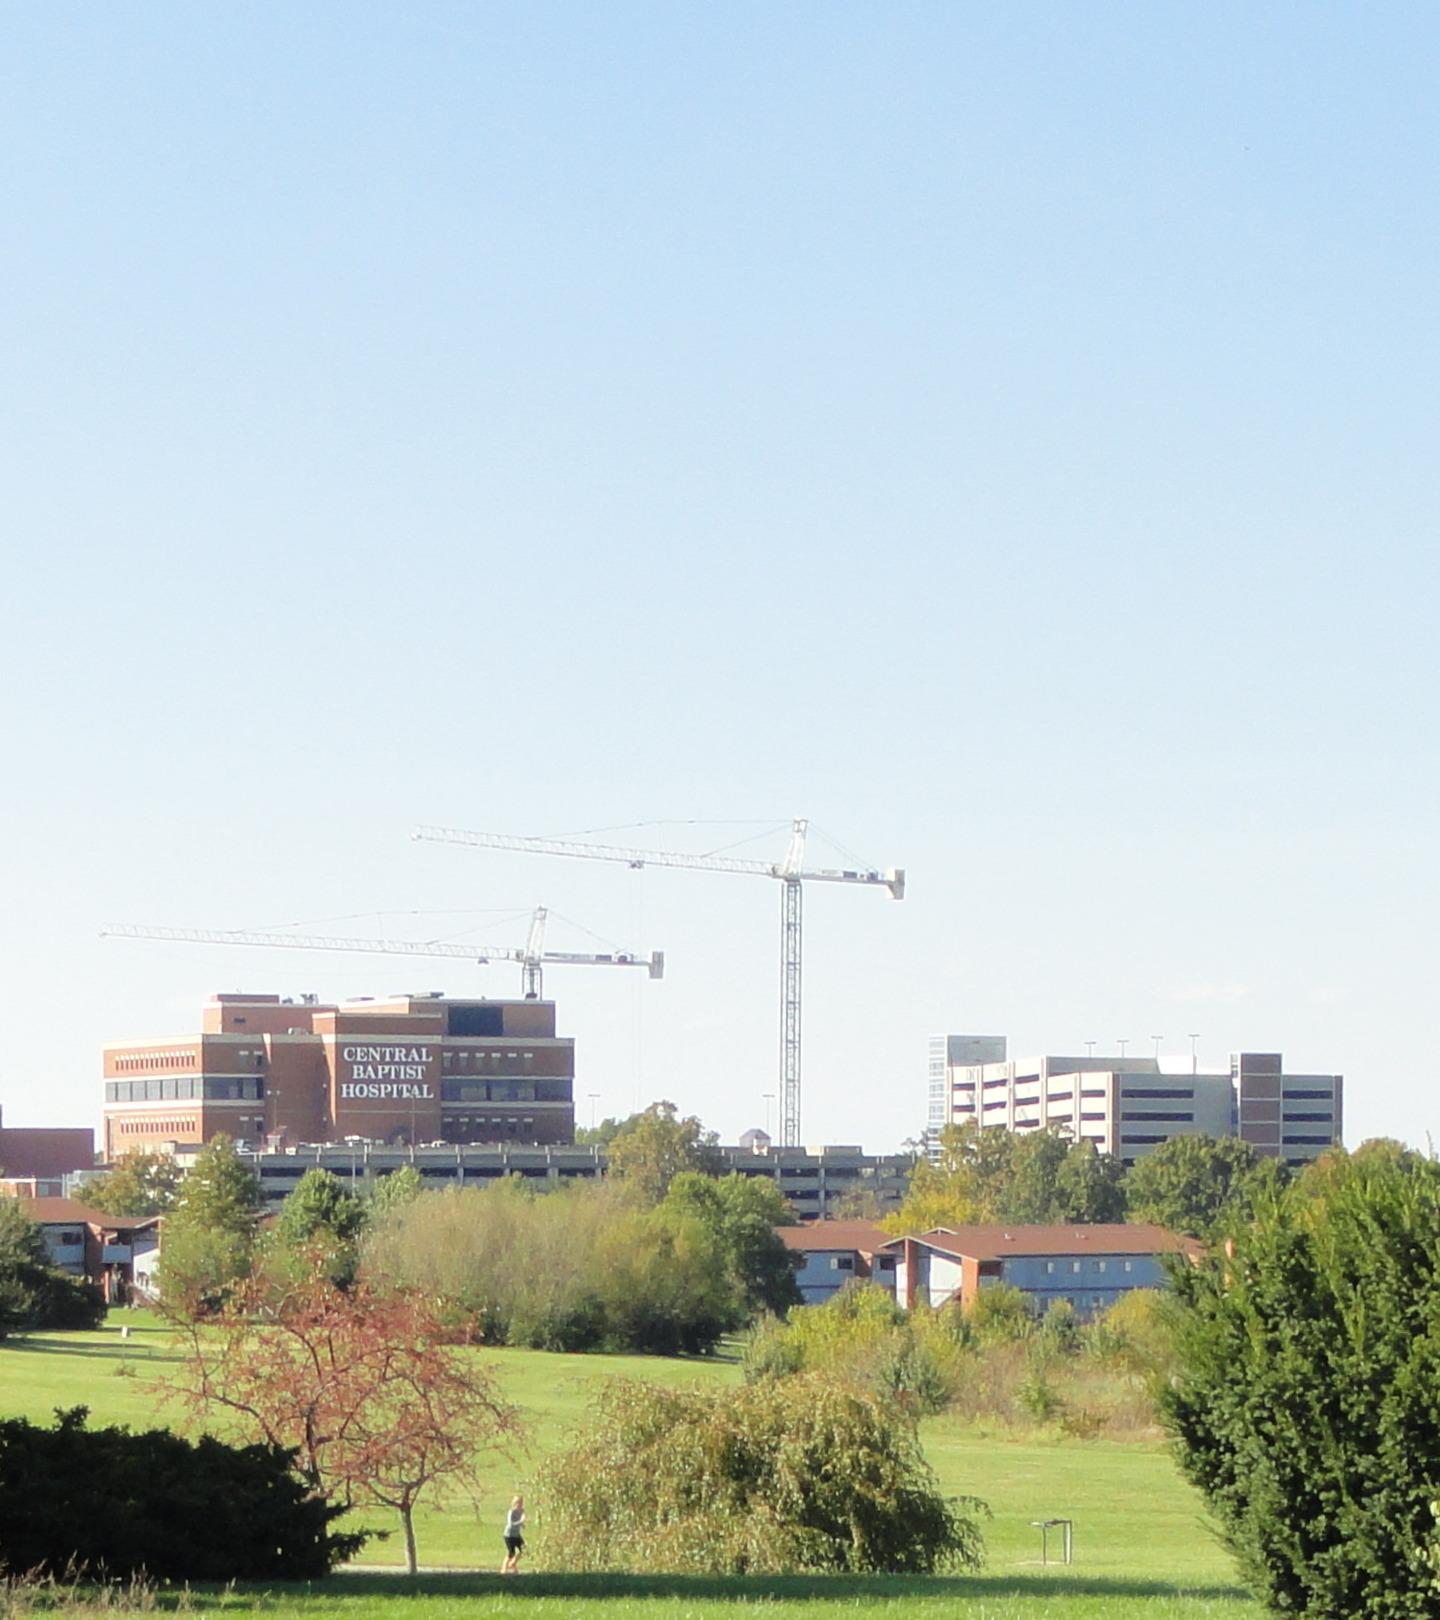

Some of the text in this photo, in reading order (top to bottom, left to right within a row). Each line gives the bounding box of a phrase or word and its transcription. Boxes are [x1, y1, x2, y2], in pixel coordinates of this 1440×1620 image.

[343, 1046, 433, 1062] CENTRAL
[352, 1064, 426, 1080] BAPTIST
[341, 1083, 435, 1099] HOSPITAL
